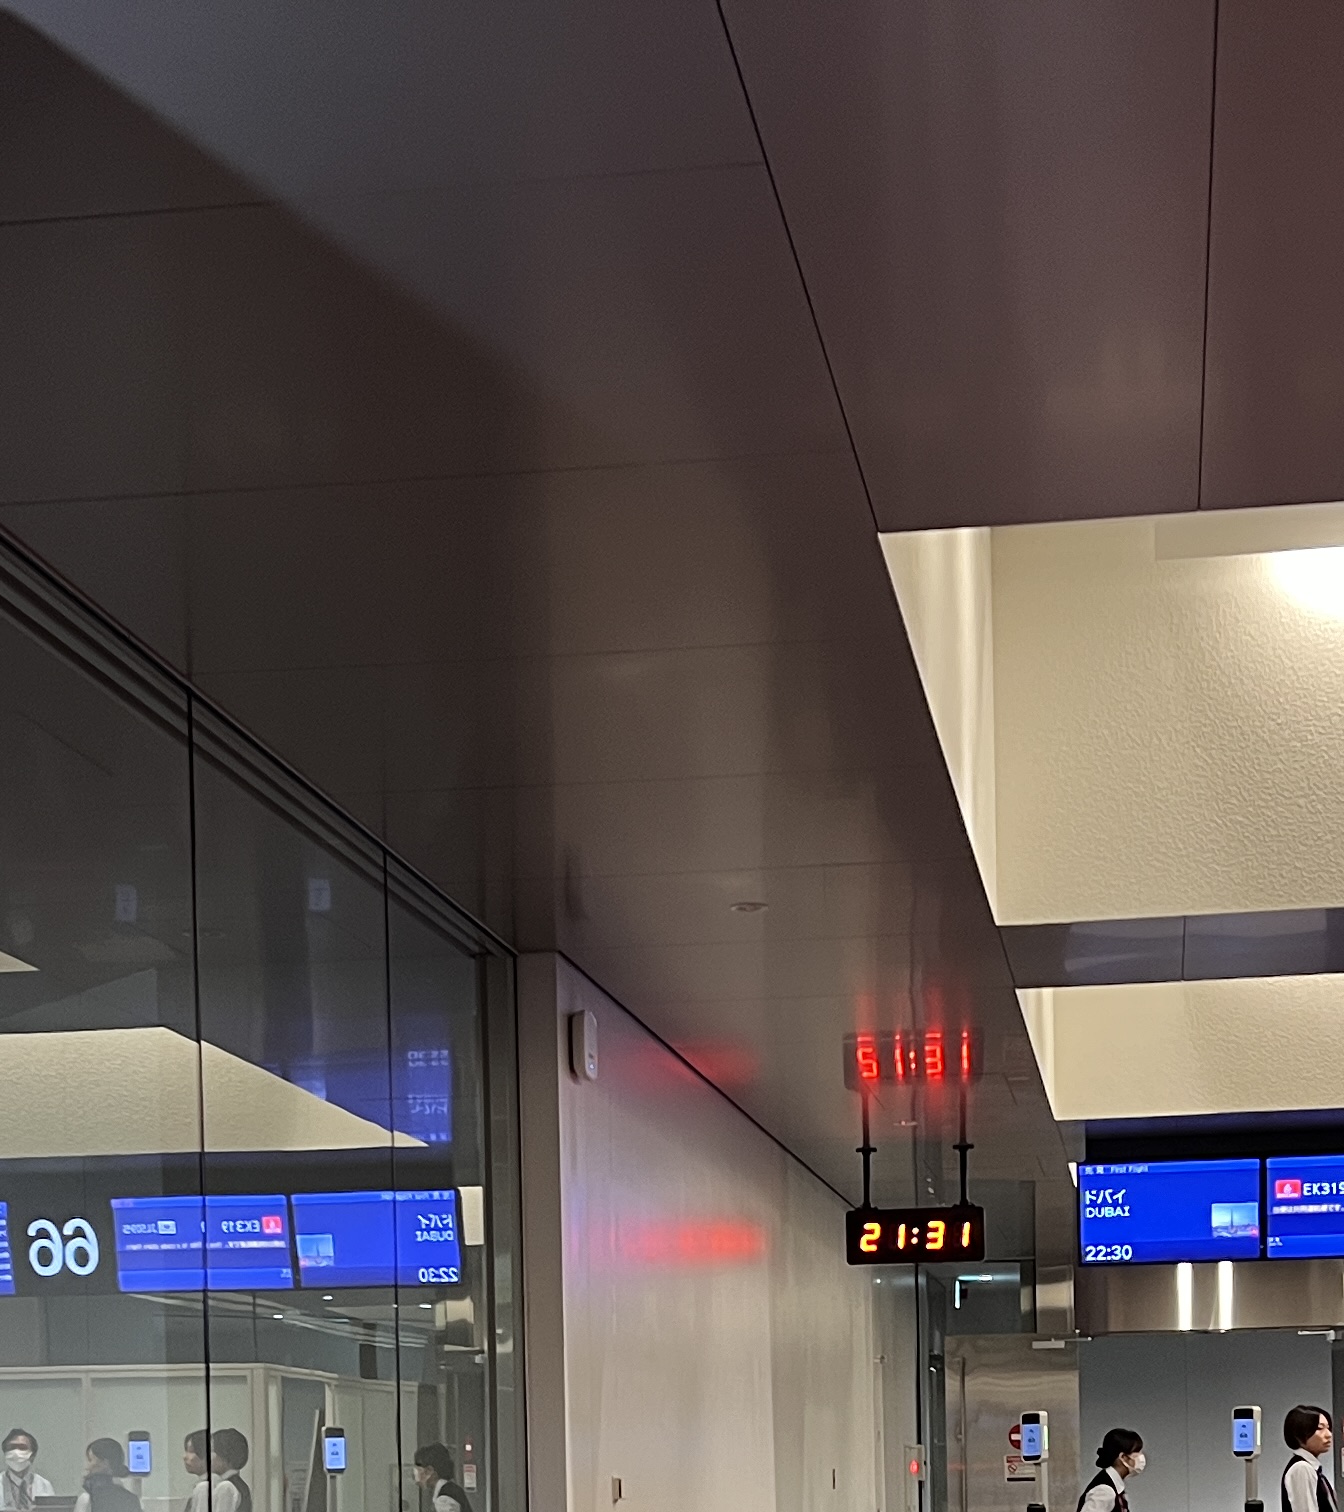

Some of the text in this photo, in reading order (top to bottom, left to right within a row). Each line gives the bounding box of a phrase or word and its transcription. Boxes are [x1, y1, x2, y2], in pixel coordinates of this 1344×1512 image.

[1085, 1189, 1126, 1205] ドバイ
[1085, 1206, 1130, 1218] DUBAI
[860, 1221, 971, 1252] 21:31
[1085, 1245, 1132, 1261] 22:30
